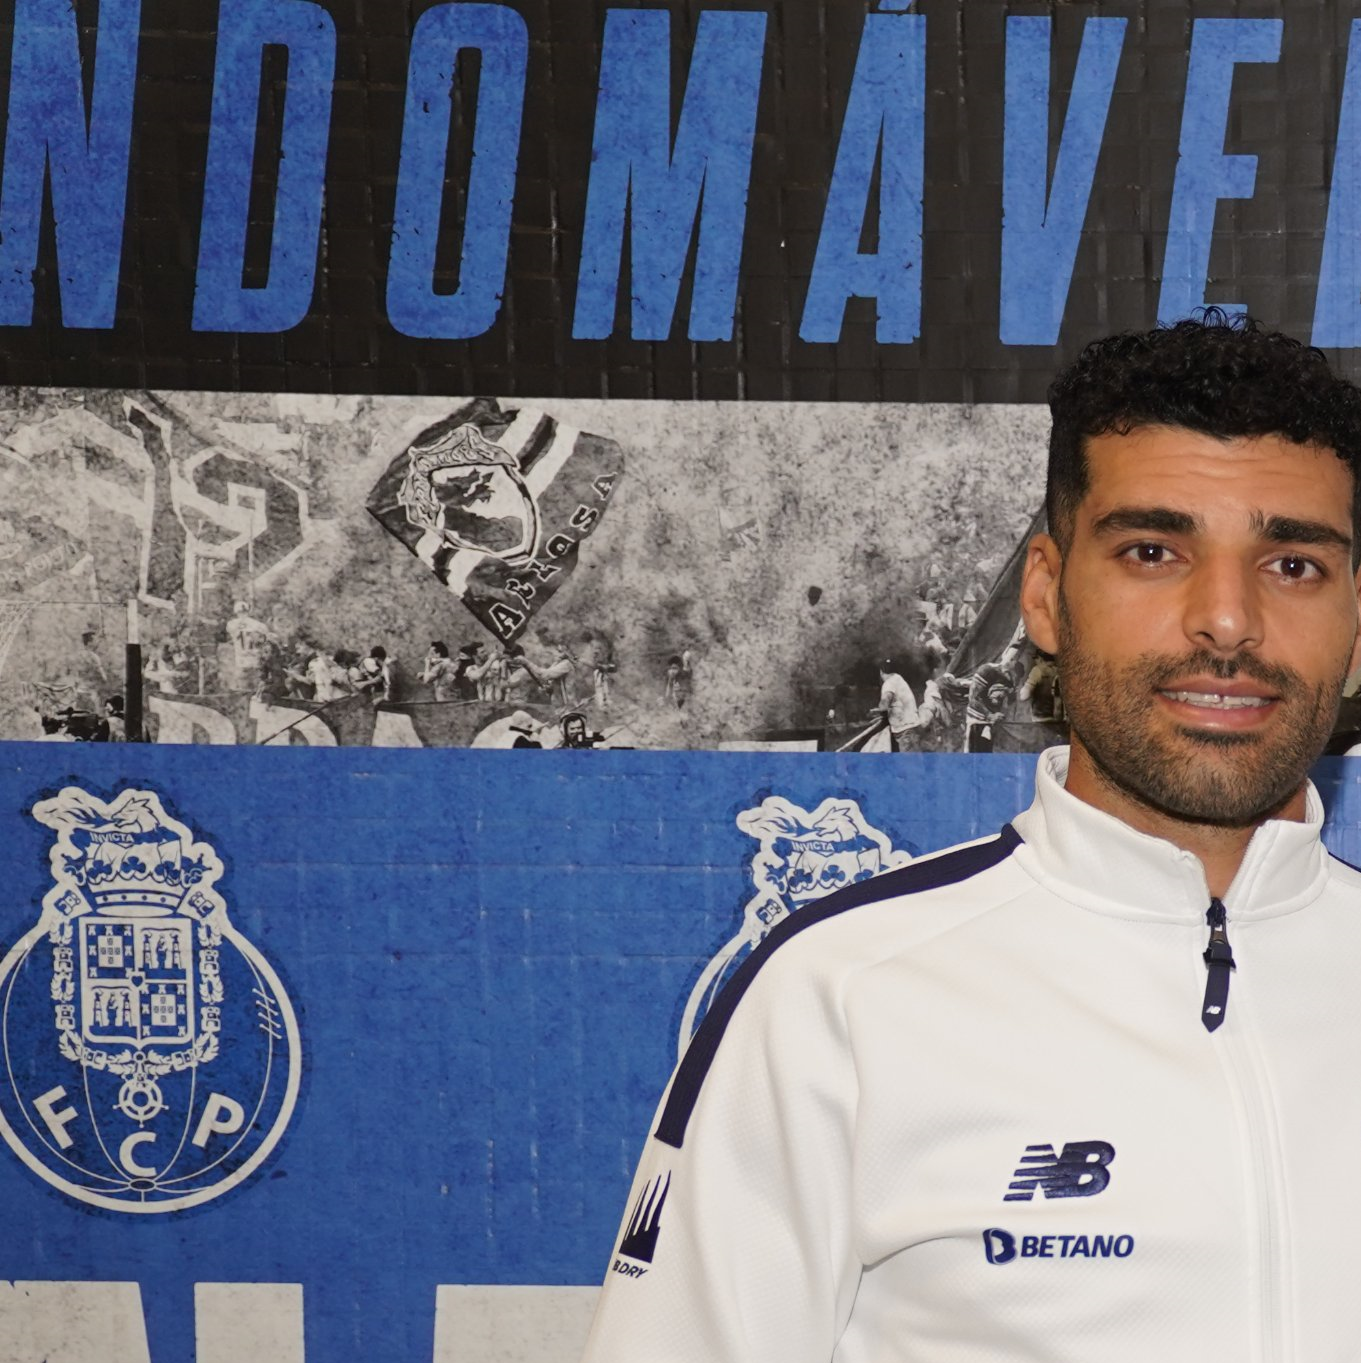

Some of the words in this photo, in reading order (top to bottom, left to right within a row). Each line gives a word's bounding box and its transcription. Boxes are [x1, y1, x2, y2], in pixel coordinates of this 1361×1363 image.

[90, 831, 134, 845] INVICTA
[792, 840, 836, 854] INVICTA
[1003, 1140, 1116, 1201] NB
[1020, 1234, 1134, 1259] BETANO
